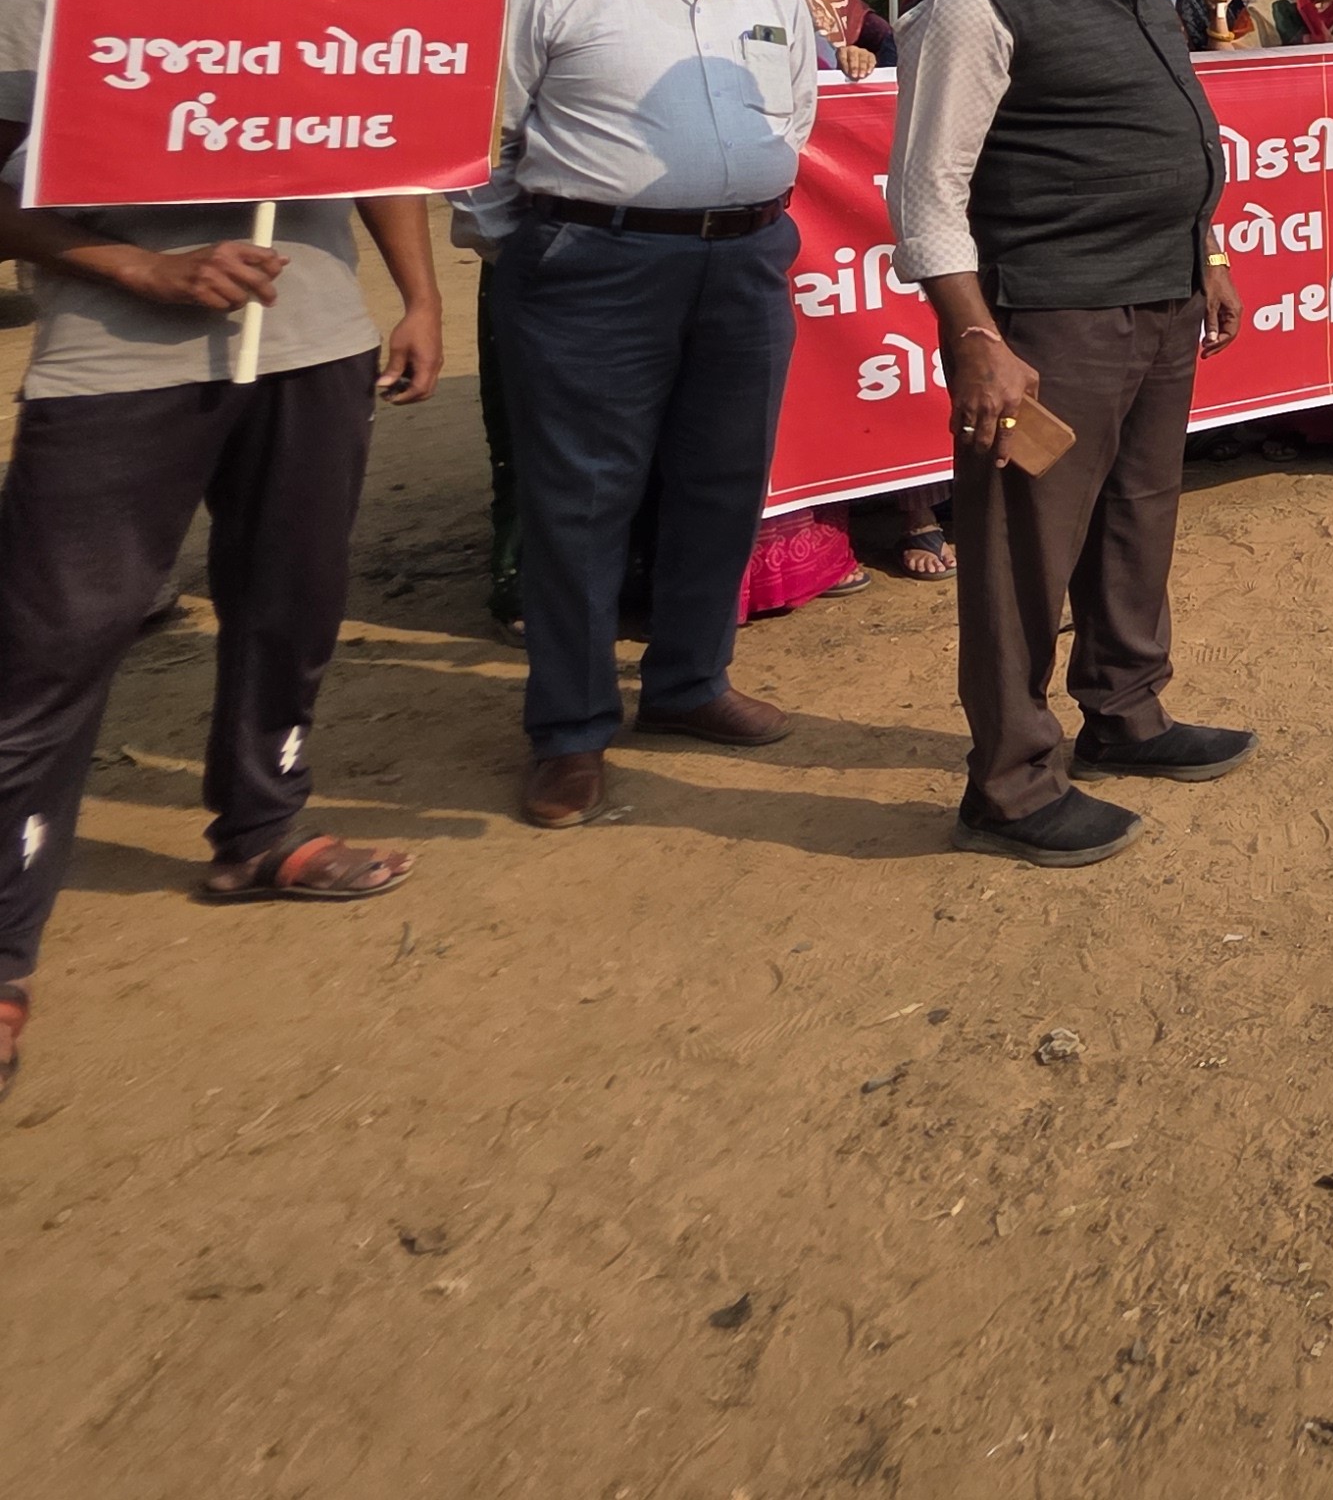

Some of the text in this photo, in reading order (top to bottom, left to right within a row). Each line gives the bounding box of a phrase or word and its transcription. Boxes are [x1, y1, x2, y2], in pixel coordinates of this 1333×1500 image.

[89, 26, 468, 89] ગુજરાત પોલીસ
[167, 92, 397, 151] જિંદાબાદ
